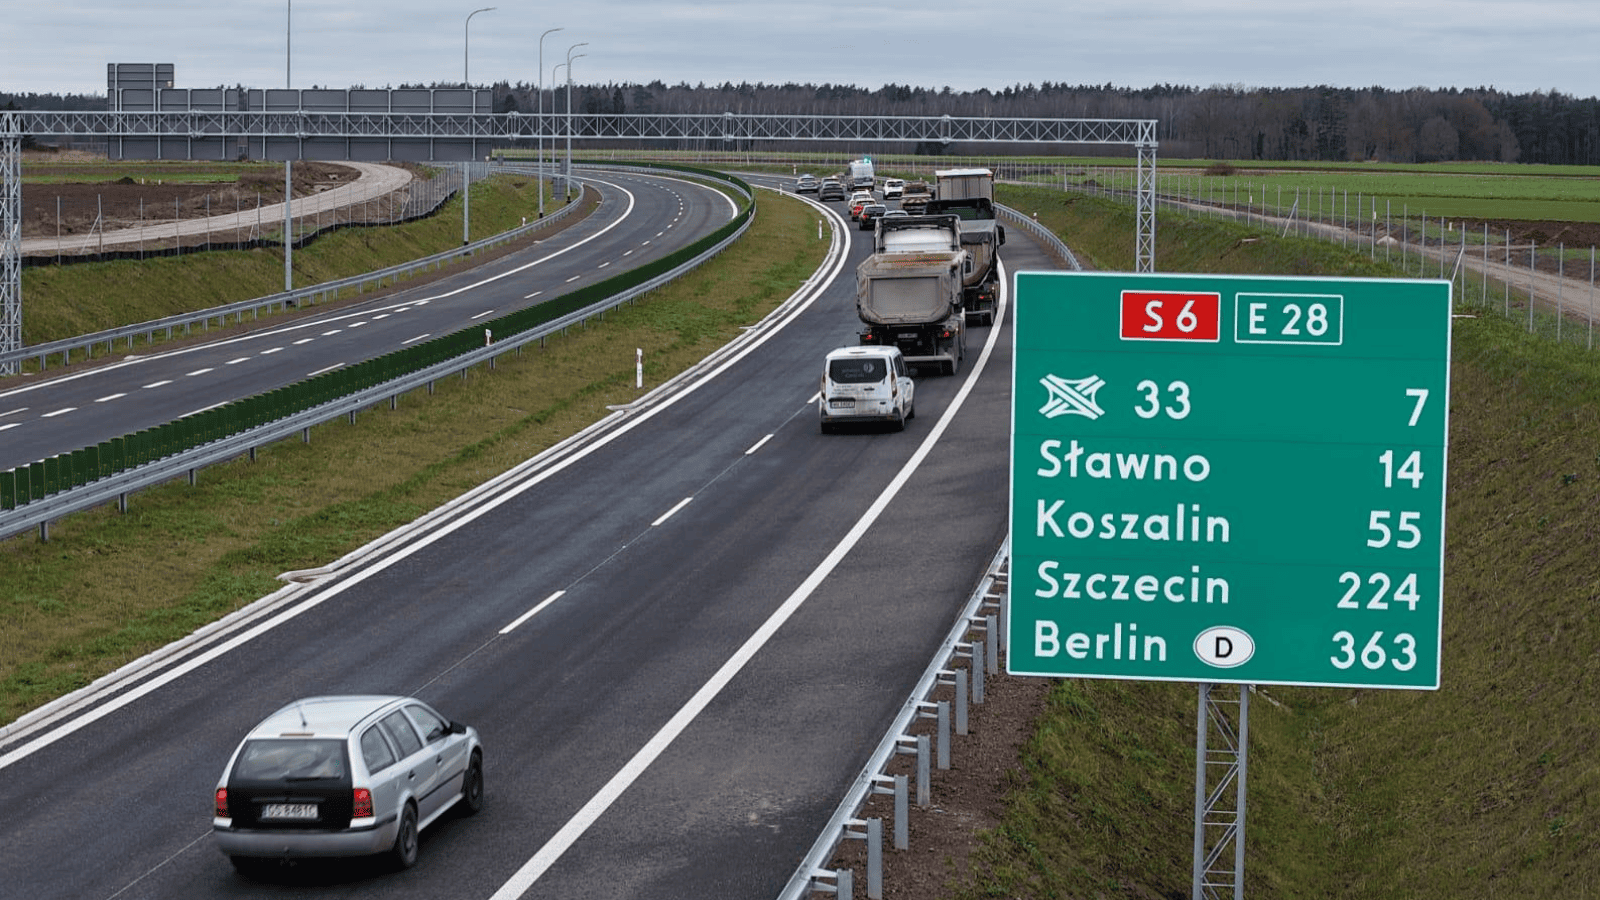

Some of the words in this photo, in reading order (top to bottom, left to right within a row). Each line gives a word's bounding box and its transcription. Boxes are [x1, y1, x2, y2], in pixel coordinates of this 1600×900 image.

[1142, 300, 1164, 333] S
[1176, 299, 1198, 333] 6
[1249, 303, 1267, 334] E
[1281, 303, 1328, 336] 28
[1134, 380, 1191, 420] 33
[1406, 388, 1429, 427] 7
[1037, 439, 1210, 482] Sławno
[1379, 450, 1424, 489] 14
[1037, 499, 1230, 542] Koszalin
[1367, 510, 1421, 549] 55
[1035, 560, 1229, 604] Szczecin
[1337, 571, 1420, 611] 224
[1035, 620, 1166, 661] Berlin
[1215, 636, 1233, 658] D
[1330, 631, 1417, 673] 363
